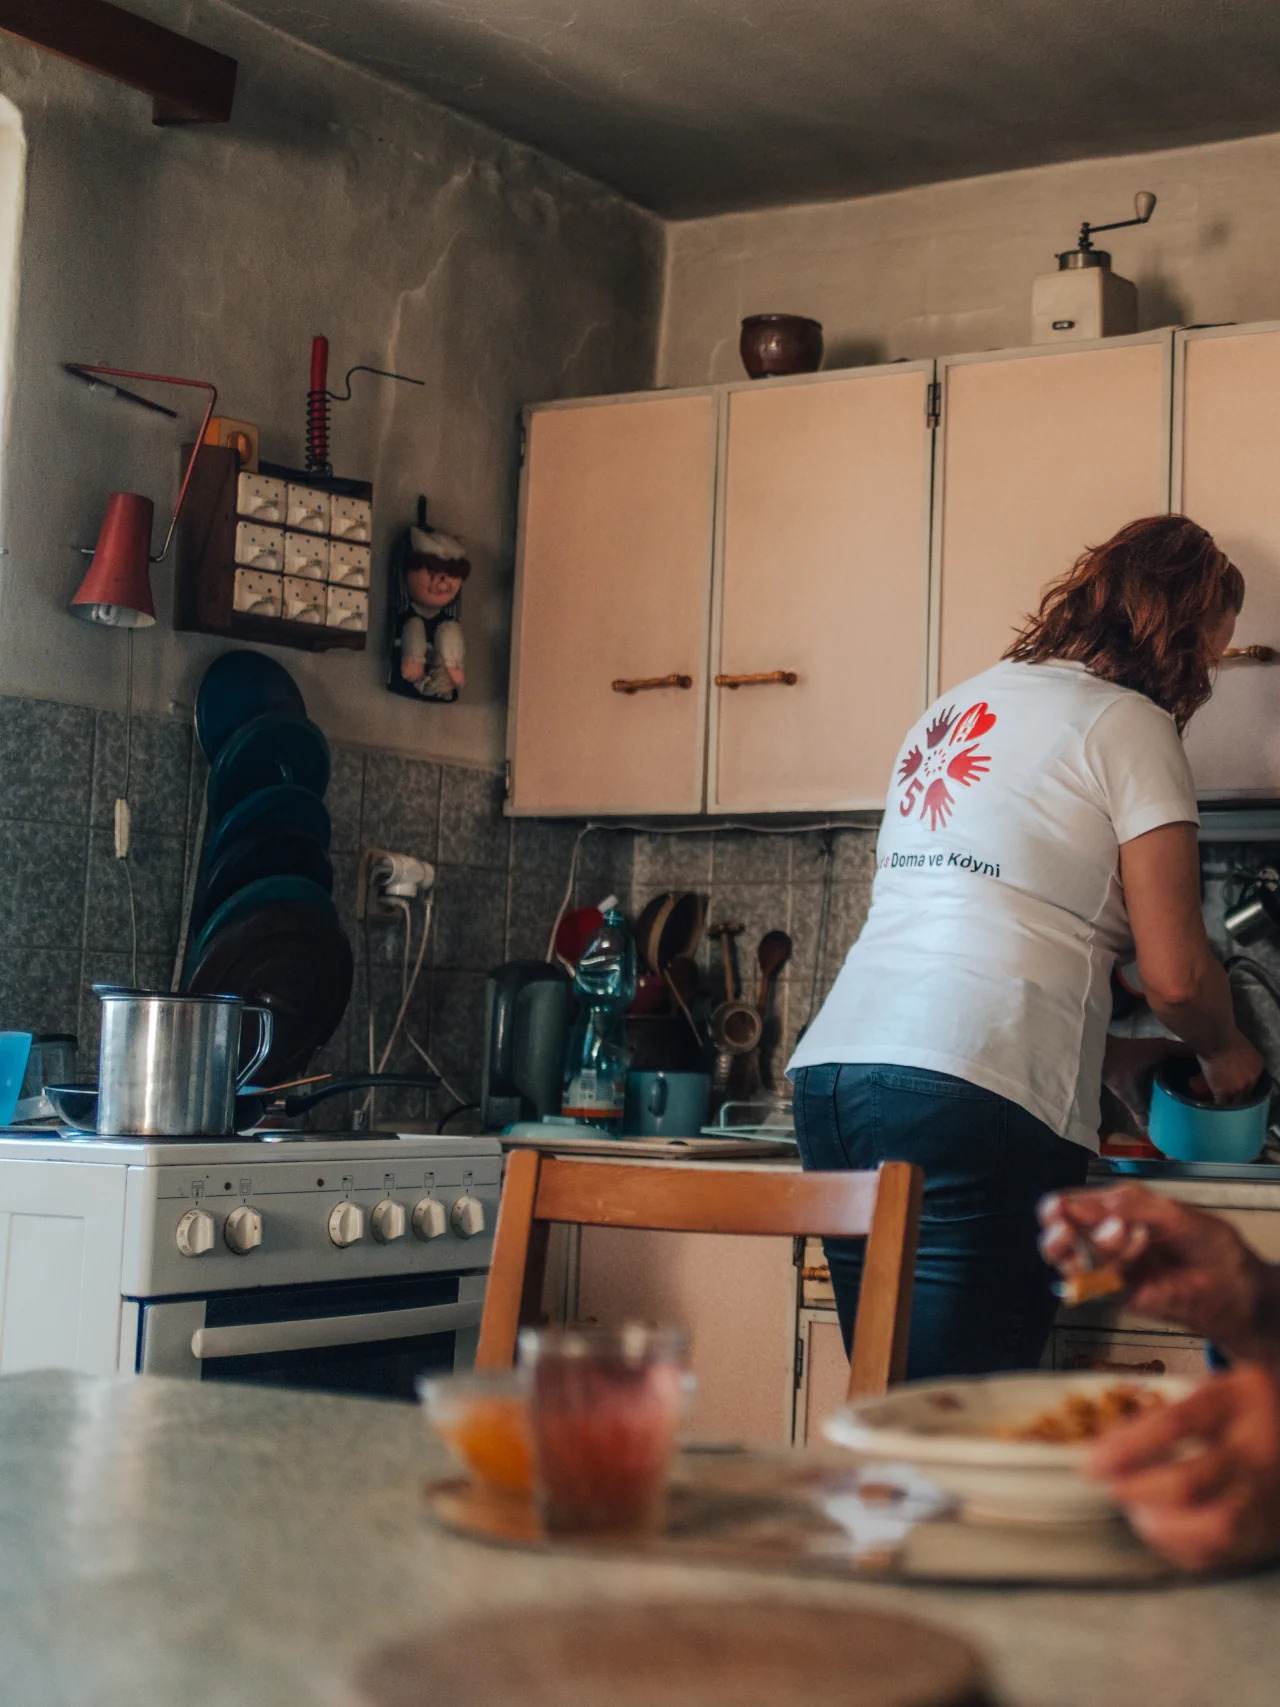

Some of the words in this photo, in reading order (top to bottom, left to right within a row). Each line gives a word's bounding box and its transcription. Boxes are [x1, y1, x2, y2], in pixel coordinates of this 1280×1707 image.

[891, 852, 926, 869] Doma
[929, 853, 944, 867] ve
[947, 852, 1001, 878] Kdyni
